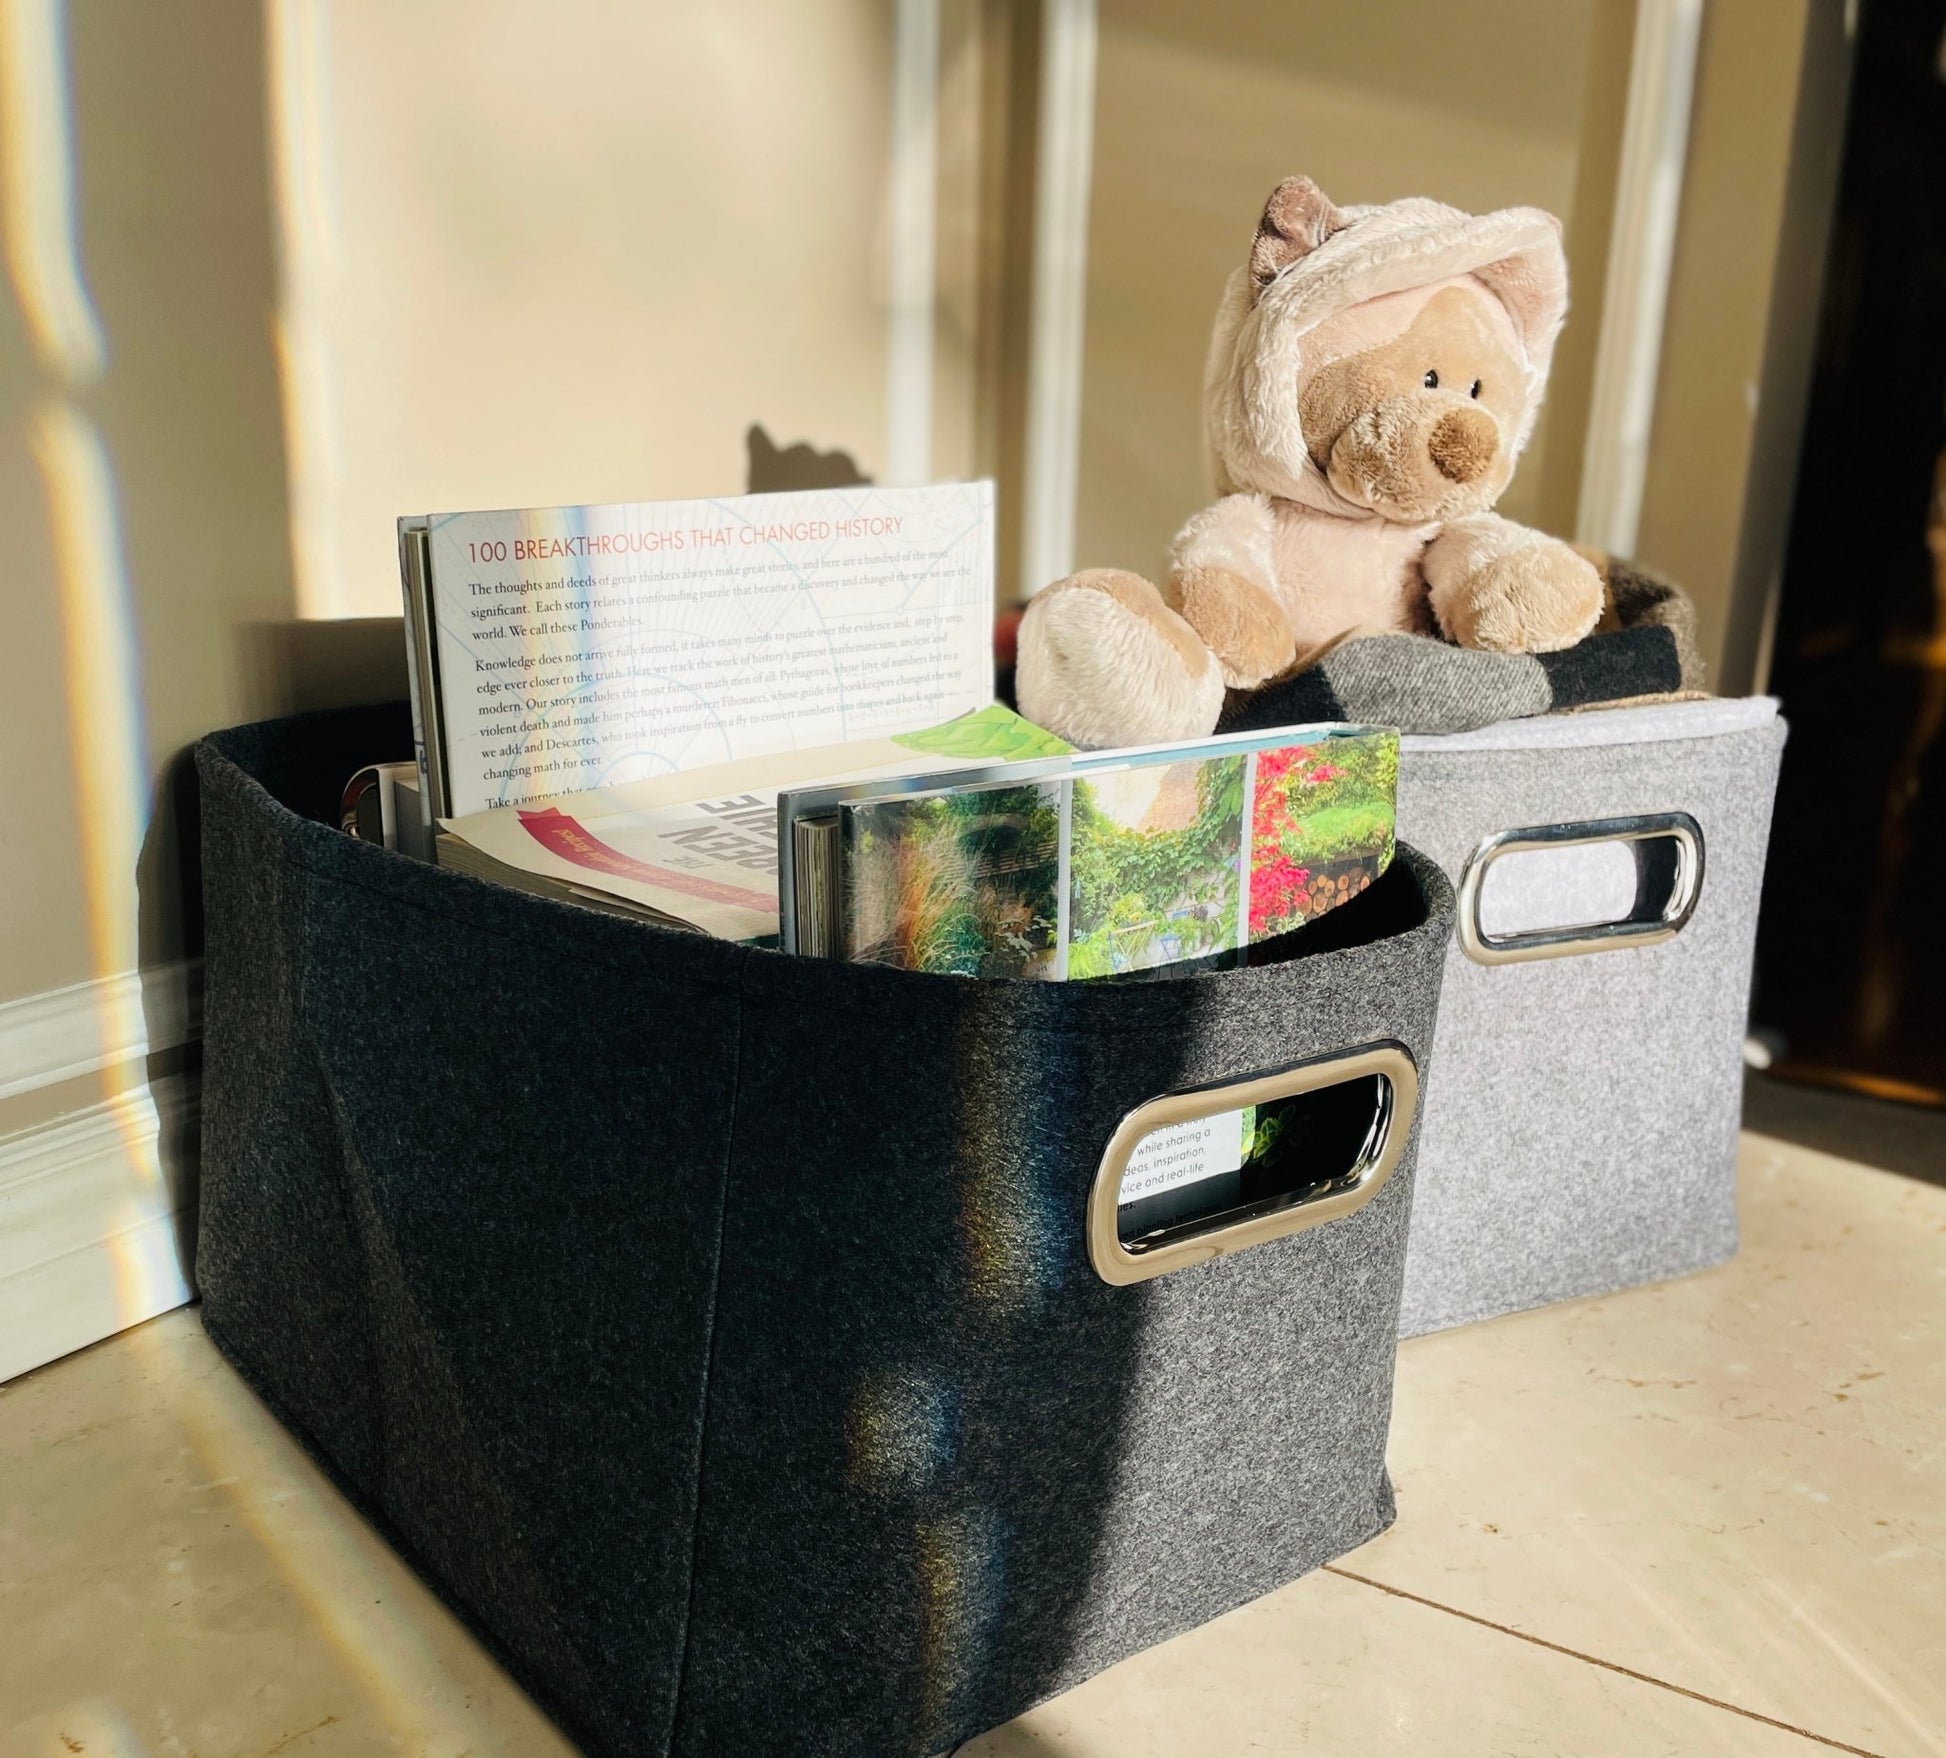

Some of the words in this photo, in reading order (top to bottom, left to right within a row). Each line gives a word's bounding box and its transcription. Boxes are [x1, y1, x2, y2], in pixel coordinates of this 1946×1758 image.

[468, 541, 506, 563] 100
[514, 530, 684, 560] BREAKTHROUGHS
[689, 527, 733, 548] THAT
[739, 521, 829, 545] CHANGED
[835, 516, 903, 538] HISTORY
[468, 583, 492, 595] The
[494, 579, 542, 595] thoughts
[544, 577, 564, 589] and
[566, 575, 596, 588] deeds
[598, 573, 609, 585] of
[611, 573, 637, 588] great
[639, 569, 680, 582] thinkers
[682, 567, 713, 580] always
[715, 564, 740, 576] make
[742, 563, 765, 577] great
[802, 558, 819, 569] and
[821, 557, 840, 568] here
[841, 558, 856, 566] are
[864, 551, 900, 564] hundred
[901, 551, 911, 561] of
[912, 550, 926, 560] the
[928, 549, 948, 559] most
[470, 603, 530, 620] significant.
[535, 599, 562, 612] Each
[563, 599, 589, 611] story
[593, 595, 626, 607] relates
[636, 589, 698, 603] confounding
[699, 585, 730, 601] puzzle
[732, 584, 751, 595] that
[753, 583, 788, 593] became
[797, 579, 839, 590] discovery
[841, 575, 857, 586] and
[858, 572, 895, 586] changed
[896, 571, 910, 581] the
[911, 572, 927, 582] way
[942, 569, 956, 577] see
[957, 566, 971, 576] the
[471, 627, 506, 640] world.
[508, 625, 527, 637] We
[529, 623, 547, 635] call
[550, 622, 577, 633] these
[475, 656, 536, 671] Knowledge
[538, 653, 562, 665] does
[564, 651, 582, 662] not
[584, 648, 613, 660] arrive
[615, 644, 638, 659] fully
[640, 640, 679, 654] formed,
[680, 640, 688, 650] it
[690, 637, 715, 649] takes
[717, 636, 743, 647] many
[744, 630, 772, 643] minds
[774, 631, 784, 640] to
[786, 626, 815, 642] puzzle
[816, 627, 836, 636] over
[837, 623, 852, 633] the
[853, 620, 891, 632] evidence
[914, 617, 932, 627] step
[933, 614, 943, 626] by
[476, 681, 501, 696] edge
[503, 680, 527, 690] ever
[529, 676, 560, 688] closer
[562, 674, 573, 684] to
[575, 671, 593, 683] the
[626, 665, 651, 677] Here
[653, 665, 667, 673] we
[670, 658, 694, 672] track
[696, 657, 712, 669] the
[714, 654, 737, 666] work
[740, 652, 750, 664] of
[791, 646, 826, 661] greatest
[899, 635, 930, 646] ancient
[932, 631, 947, 642] and
[478, 701, 523, 715] modern.
[525, 698, 547, 709] Our
[550, 696, 575, 708] story
[578, 689, 620, 704] includes
[622, 687, 637, 699] the
[640, 685, 664, 696] most
[667, 681, 702, 693] famous
[704, 675, 729, 688] math
[730, 675, 750, 685] men
[752, 671, 762, 682] of
[779, 666, 831, 682] Pythagoras,
[861, 659, 878, 670] love
[880, 657, 890, 667] of
[928, 651, 942, 662] led
[479, 722, 517, 736] violent
[519, 717, 549, 731] death
[551, 714, 571, 727] and
[573, 711, 601, 725] made
[602, 710, 622, 721] him
[624, 705, 664, 722] perhaps
[770, 689, 798, 700] whose
[800, 684, 824, 700] guide
[825, 683, 839, 694] for
[895, 671, 930, 686] changed
[931, 670, 945, 681] the
[481, 748, 496, 757] we
[524, 739, 543, 752] and
[546, 735, 599, 749] Descartes,
[601, 729, 623, 742] who
[624, 725, 647, 739] took
[649, 721, 702, 737] inspiration
[704, 718, 726, 729] from
[735, 713, 748, 727] fly
[749, 713, 760, 723] to
[761, 708, 794, 721] convert
[797, 704, 834, 716] numbers
[836, 701, 854, 711] into
[885, 693, 901, 705] and
[482, 765, 532, 780] changing
[533, 758, 560, 773] math
[562, 758, 578, 769] for
[484, 796, 511, 810] Take
[696, 795, 777, 840] HIE
[657, 825, 778, 876] REEN
[662, 856, 713, 869] THE
[1137, 1142, 1163, 1156] while
[1166, 1131, 1201, 1148] sharing
[1204, 1128, 1211, 1138] a
[1123, 1164, 1151, 1177] deas,
[1145, 1172, 1165, 1187] and
[1167, 1162, 1205, 1181] real-life
